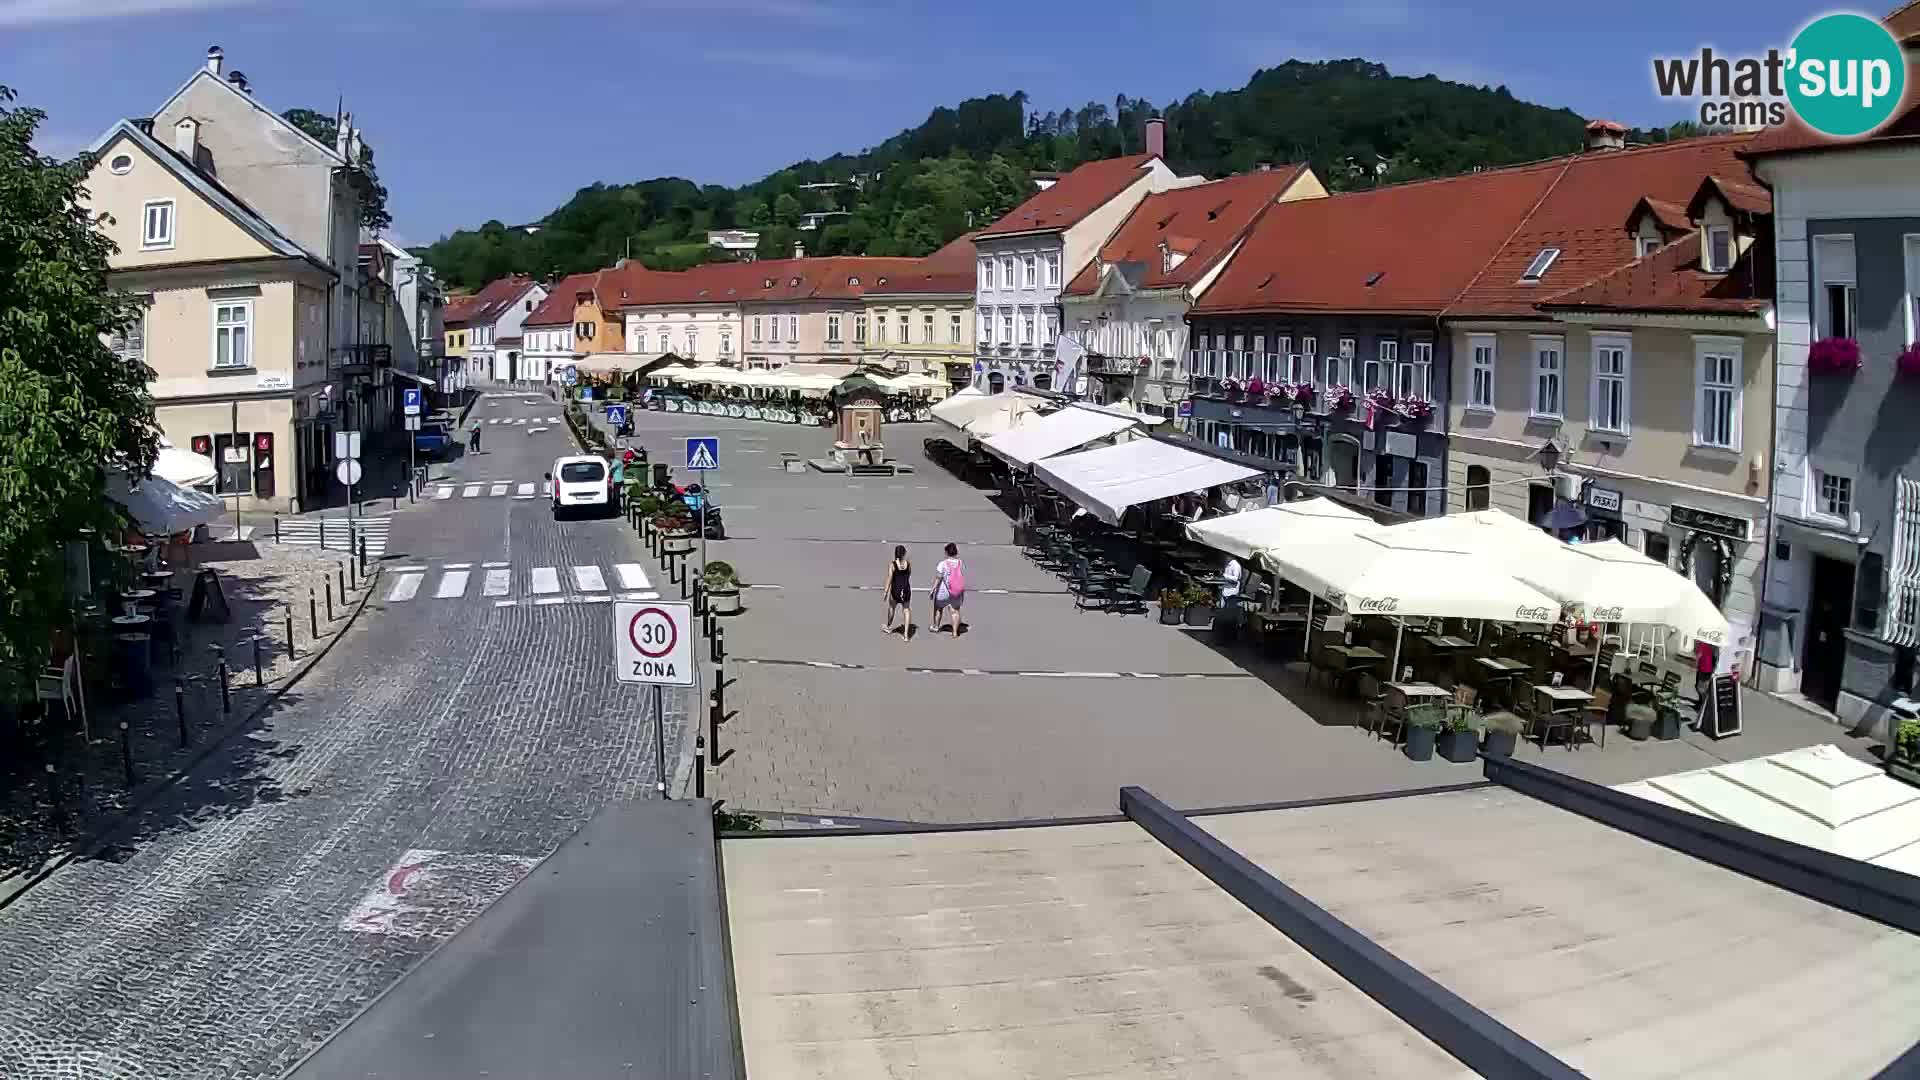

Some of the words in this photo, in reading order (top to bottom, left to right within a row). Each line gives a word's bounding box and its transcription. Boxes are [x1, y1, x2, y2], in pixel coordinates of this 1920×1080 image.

[408, 392, 416, 404] P
[641, 623, 666, 644] 30
[632, 661, 676, 677] ZONA
